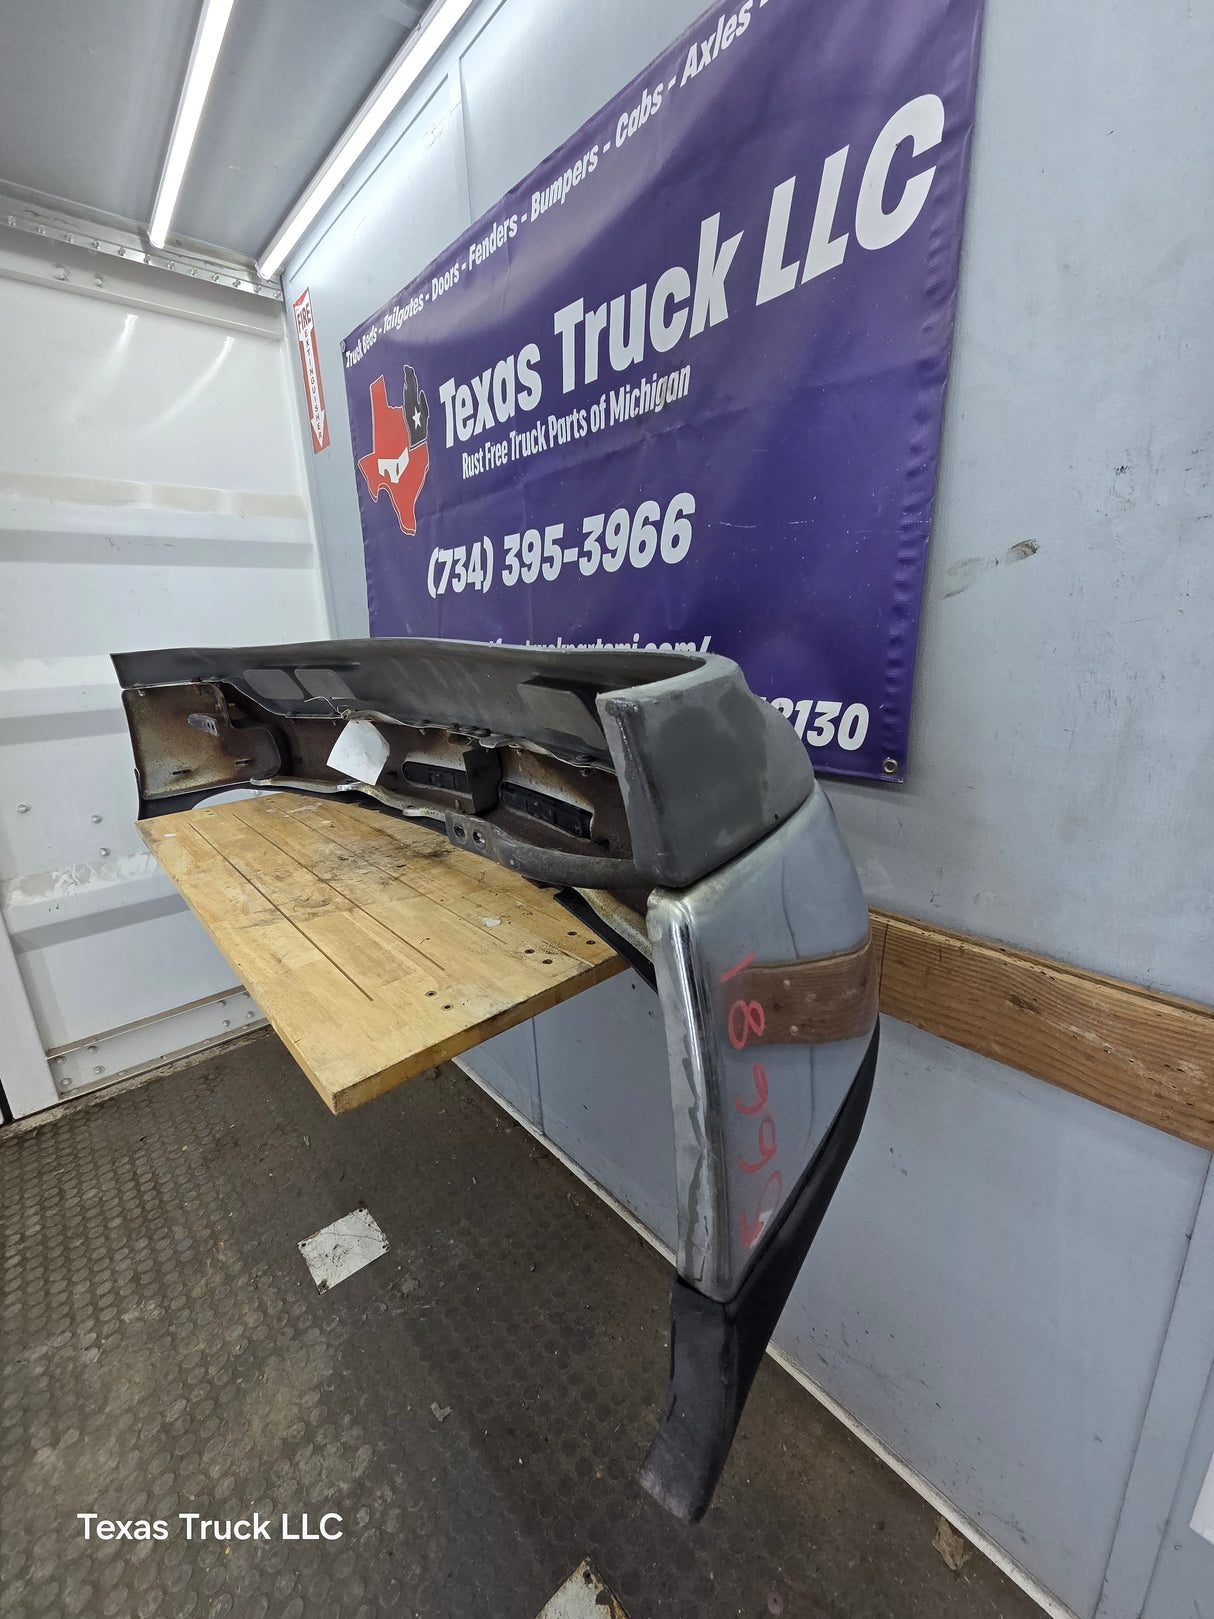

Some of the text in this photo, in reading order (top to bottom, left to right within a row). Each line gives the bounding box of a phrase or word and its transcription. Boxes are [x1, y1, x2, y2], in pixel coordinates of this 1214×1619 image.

[345, 340, 363, 368] Truck
[362, 324, 378, 354] Beds
[383, 293, 424, 335] Tailgates
[431, 262, 460, 302] Doors
[469, 213, 518, 271] Fenders
[531, 144, 599, 222] Bumpers
[616, 83, 663, 148] Cabs
[680, 3, 752, 88] Axles
[297, 302, 311, 333] FIRE
[439, 94, 945, 449] Texas Truck LLC
[304, 330, 323, 439] EXTINGUISHER
[462, 364, 691, 480] Rust Free Truck Parts of Michigan
[427, 493, 696, 599] (734) 395-3966
